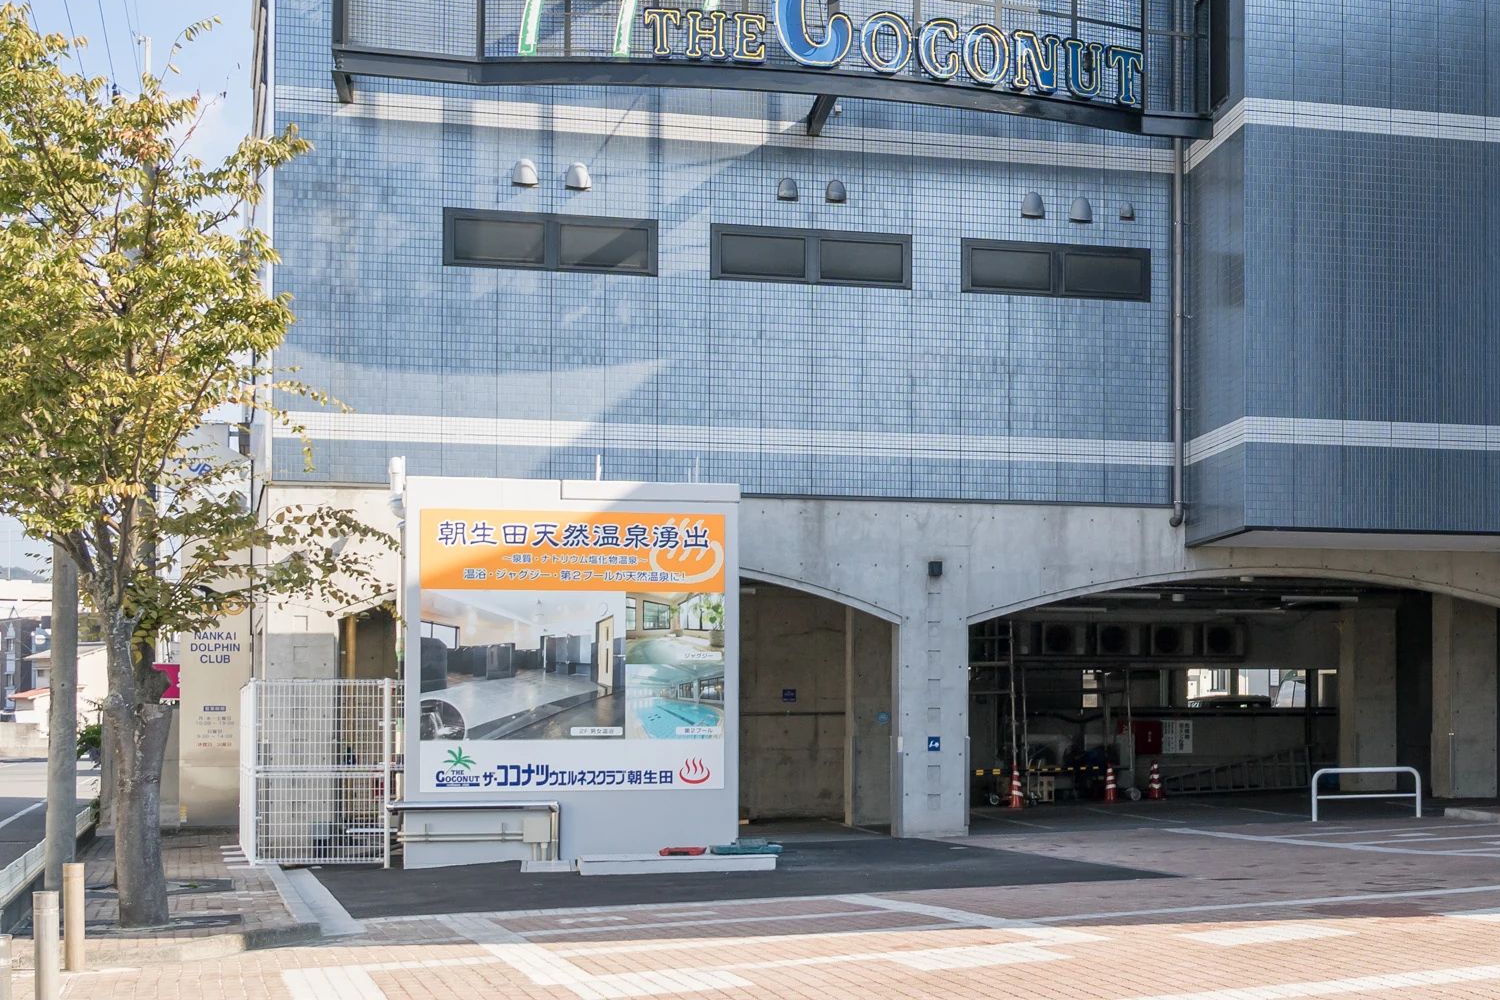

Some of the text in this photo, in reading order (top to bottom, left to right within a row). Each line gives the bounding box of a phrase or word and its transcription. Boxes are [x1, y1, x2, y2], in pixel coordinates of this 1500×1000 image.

[644, 6, 767, 63] THE
[437, 520, 711, 550] 朝生田天然温泉湧出
[194, 631, 237, 641] NANKAI
[190, 643, 241, 652] DOLPHIN
[200, 654, 231, 664] CLUB
[435, 770, 480, 784] COCONUT
